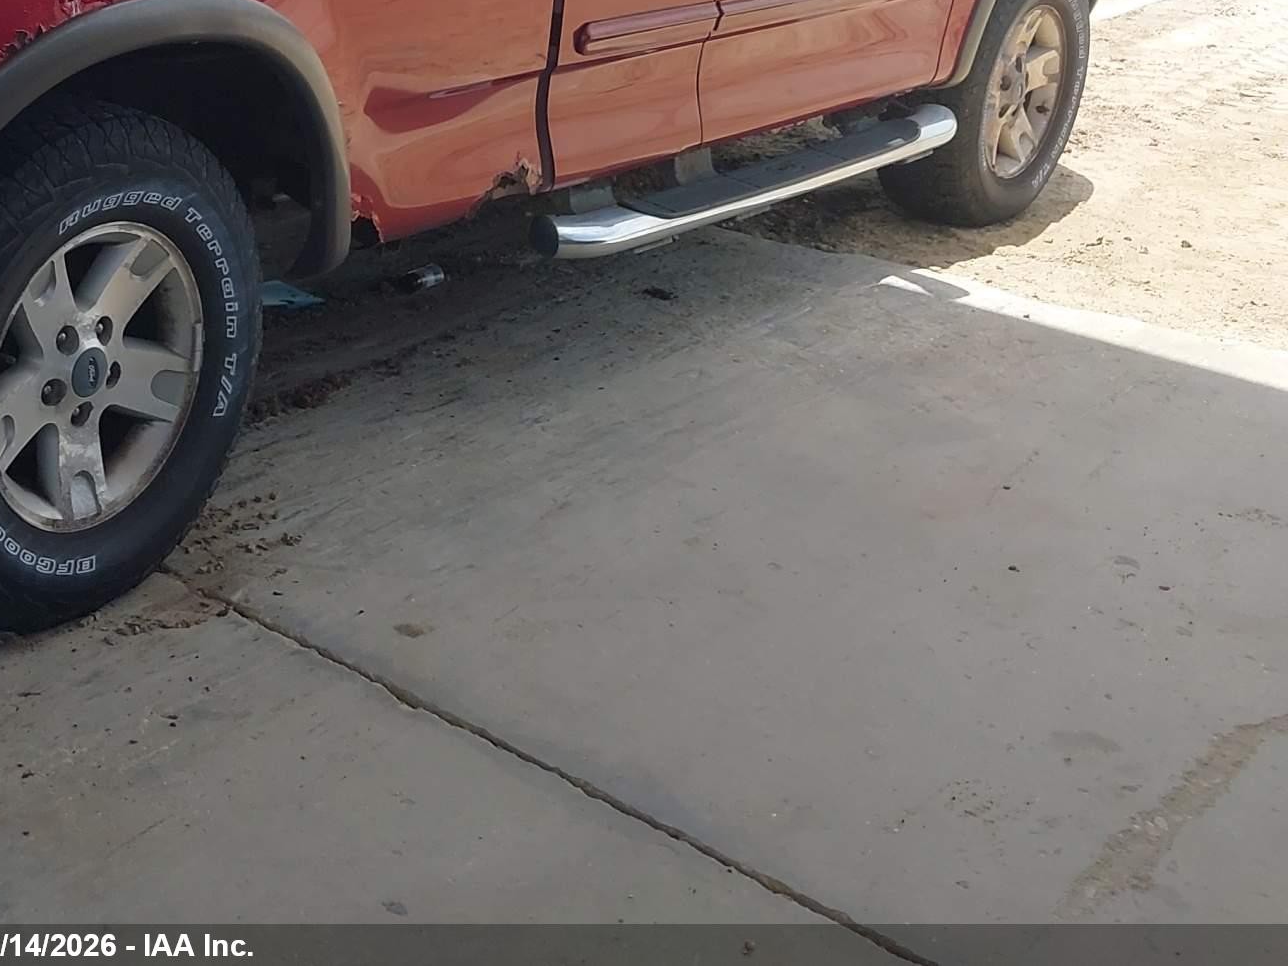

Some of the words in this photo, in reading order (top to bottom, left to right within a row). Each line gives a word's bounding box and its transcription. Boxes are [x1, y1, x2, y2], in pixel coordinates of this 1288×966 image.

[59, 190, 183, 235] Rugged
[184, 207, 239, 338] Terrain
[213, 353, 237, 417] T/A
